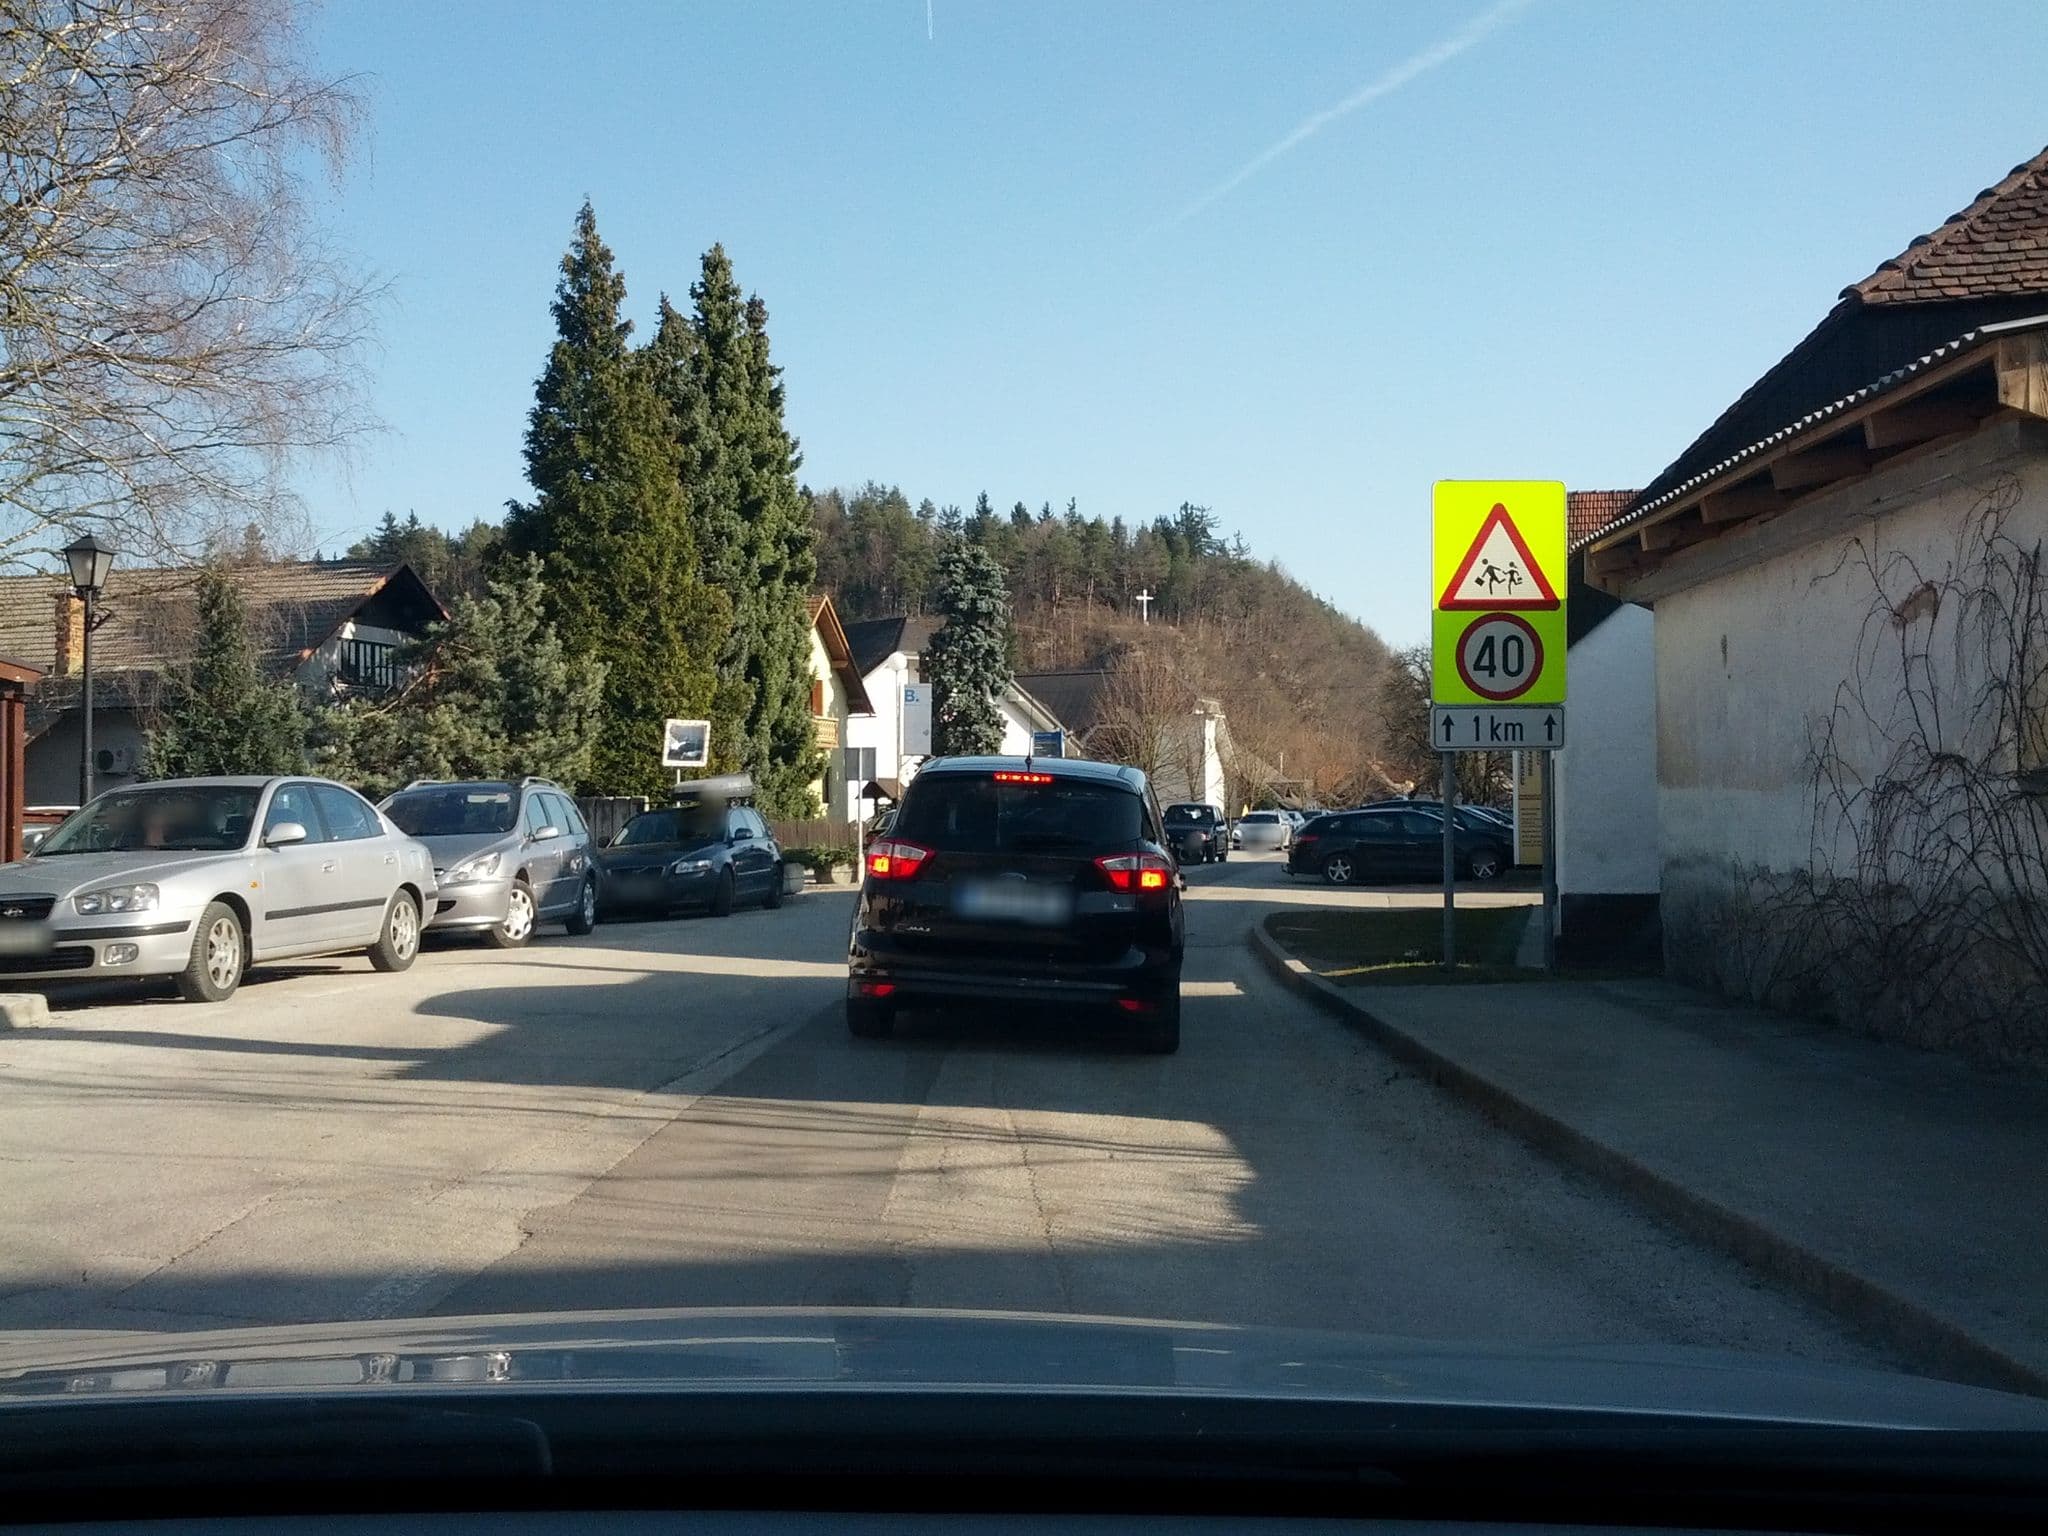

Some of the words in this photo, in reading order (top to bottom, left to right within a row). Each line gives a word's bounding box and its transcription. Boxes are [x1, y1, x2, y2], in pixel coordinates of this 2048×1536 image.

[1473, 635, 1524, 677] 40
[1473, 715, 1480, 742] 1
[1490, 715, 1524, 742] km
